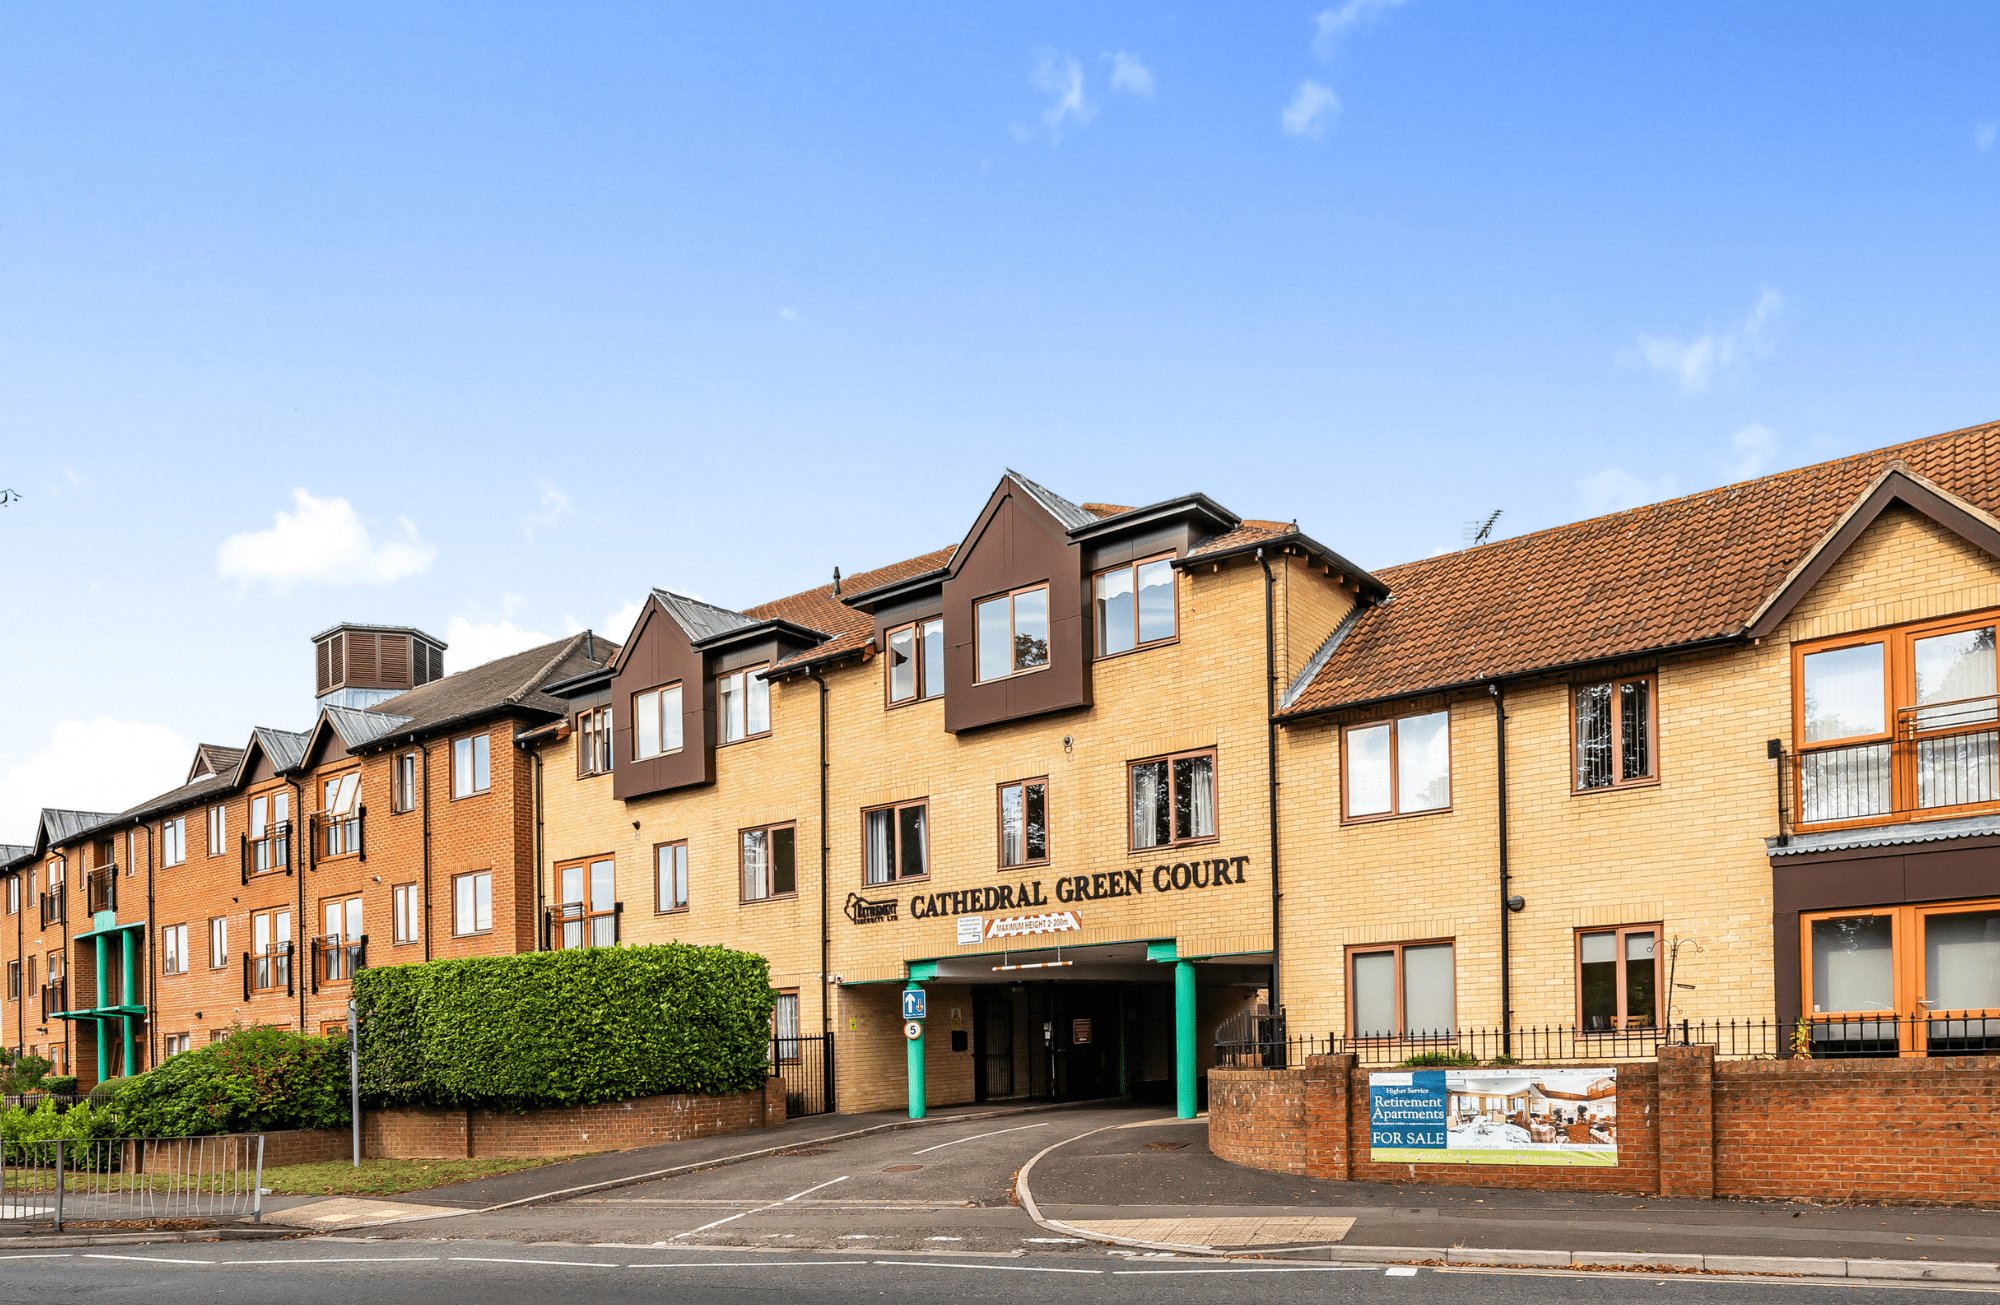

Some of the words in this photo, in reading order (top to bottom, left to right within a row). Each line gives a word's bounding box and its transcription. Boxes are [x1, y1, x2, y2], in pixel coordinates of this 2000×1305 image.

[911, 881, 1047, 919] CATHEDRAL
[1056, 868, 1143, 903] GREEN
[1153, 856, 1249, 892] COURT
[996, 922, 1024, 932] MAXIMUM
[1025, 919, 1047, 930] HEIGHT
[910, 1025, 916, 1035] 5
[1386, 1087, 1406, 1095] Higher
[1375, 1095, 1442, 1107] Retirement
[1372, 1107, 1445, 1121] Apartments
[1372, 1132, 1403, 1144] FOR
[1406, 1132, 1445, 1144] SALE
